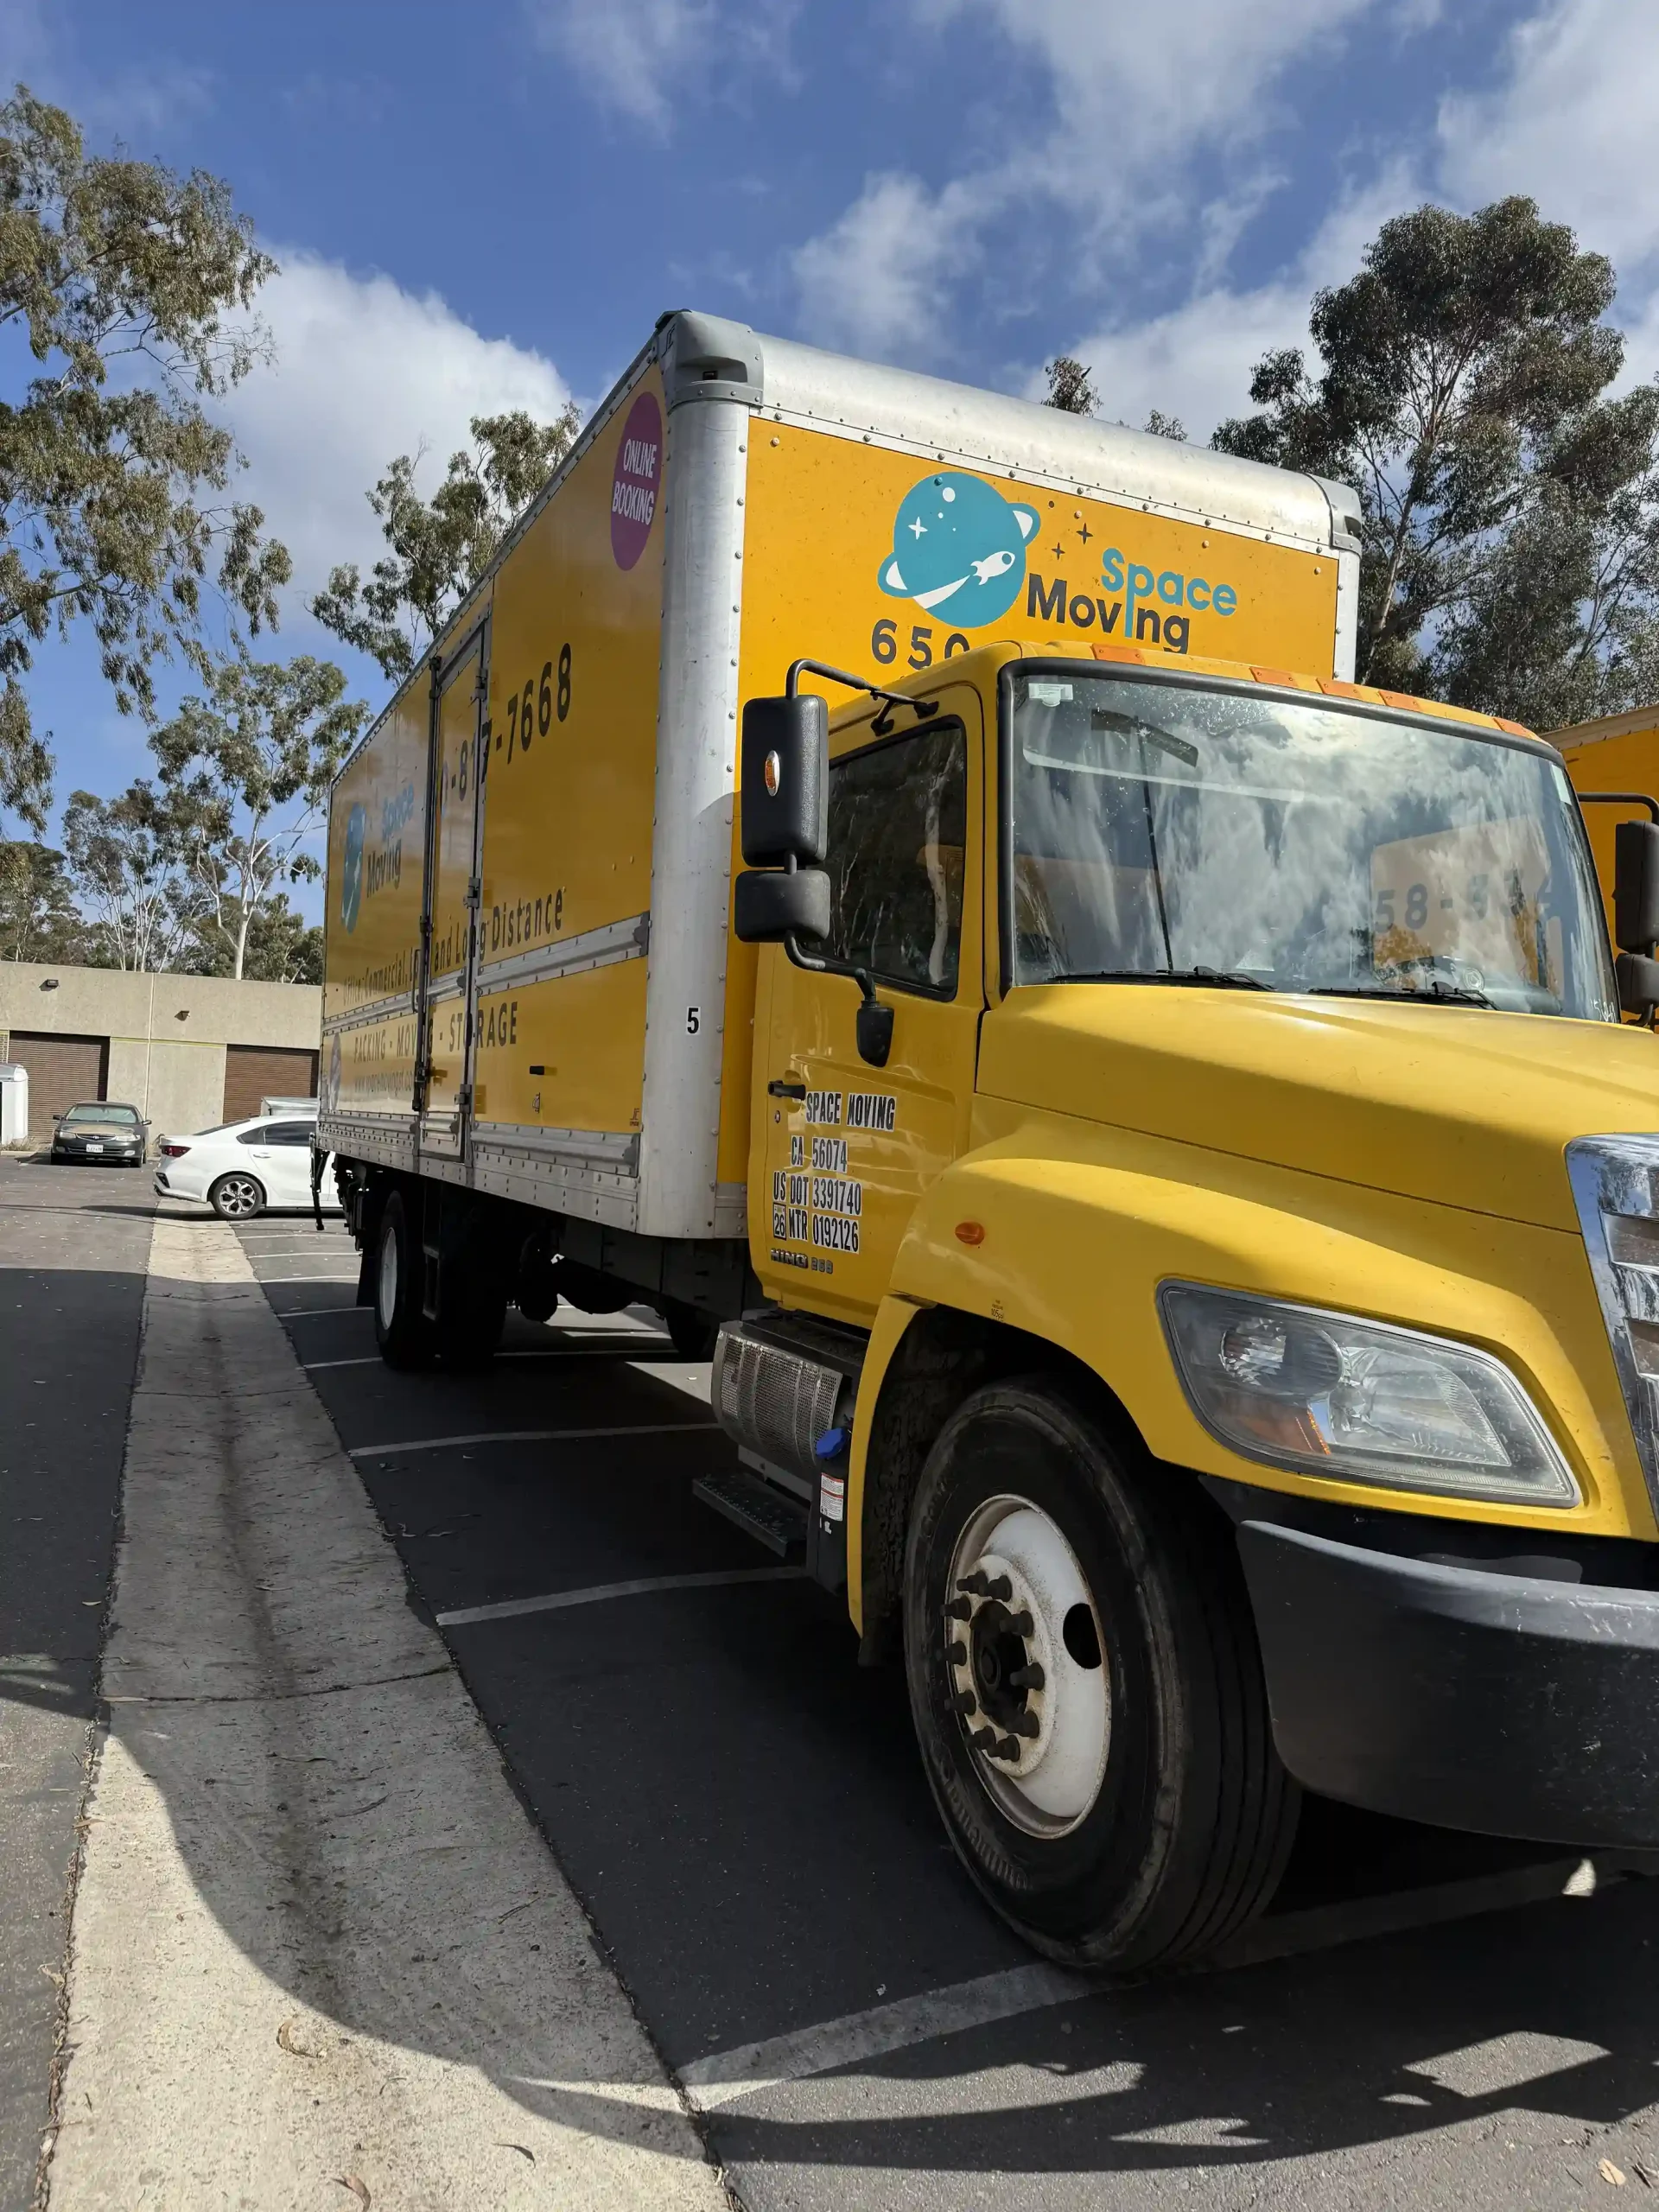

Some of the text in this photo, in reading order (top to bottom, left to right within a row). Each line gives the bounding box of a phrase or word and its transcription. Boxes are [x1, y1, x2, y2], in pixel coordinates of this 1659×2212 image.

[623, 439, 658, 479] ONLINE
[612, 481, 655, 525] BOOKING
[1027, 572, 1190, 655] Moving
[1101, 547, 1238, 638] Space
[382, 783, 415, 843] Space
[366, 838, 402, 899] Moving
[434, 925, 453, 972] and
[456, 921, 486, 962] Long
[492, 888, 563, 952] Distance
[353, 1029, 386, 1064] PACKING
[397, 1018, 434, 1058] MOVG
[687, 1007, 699, 1034] 5
[806, 1092, 896, 1130] SPACE MOVING
[791, 1136, 848, 1173] CA 56074
[773, 1172, 861, 1216] US DOT 3391740
[774, 1212, 785, 1236] 26
[788, 1208, 859, 1253] MTR 0192126
[771, 1248, 809, 1269] HINO
